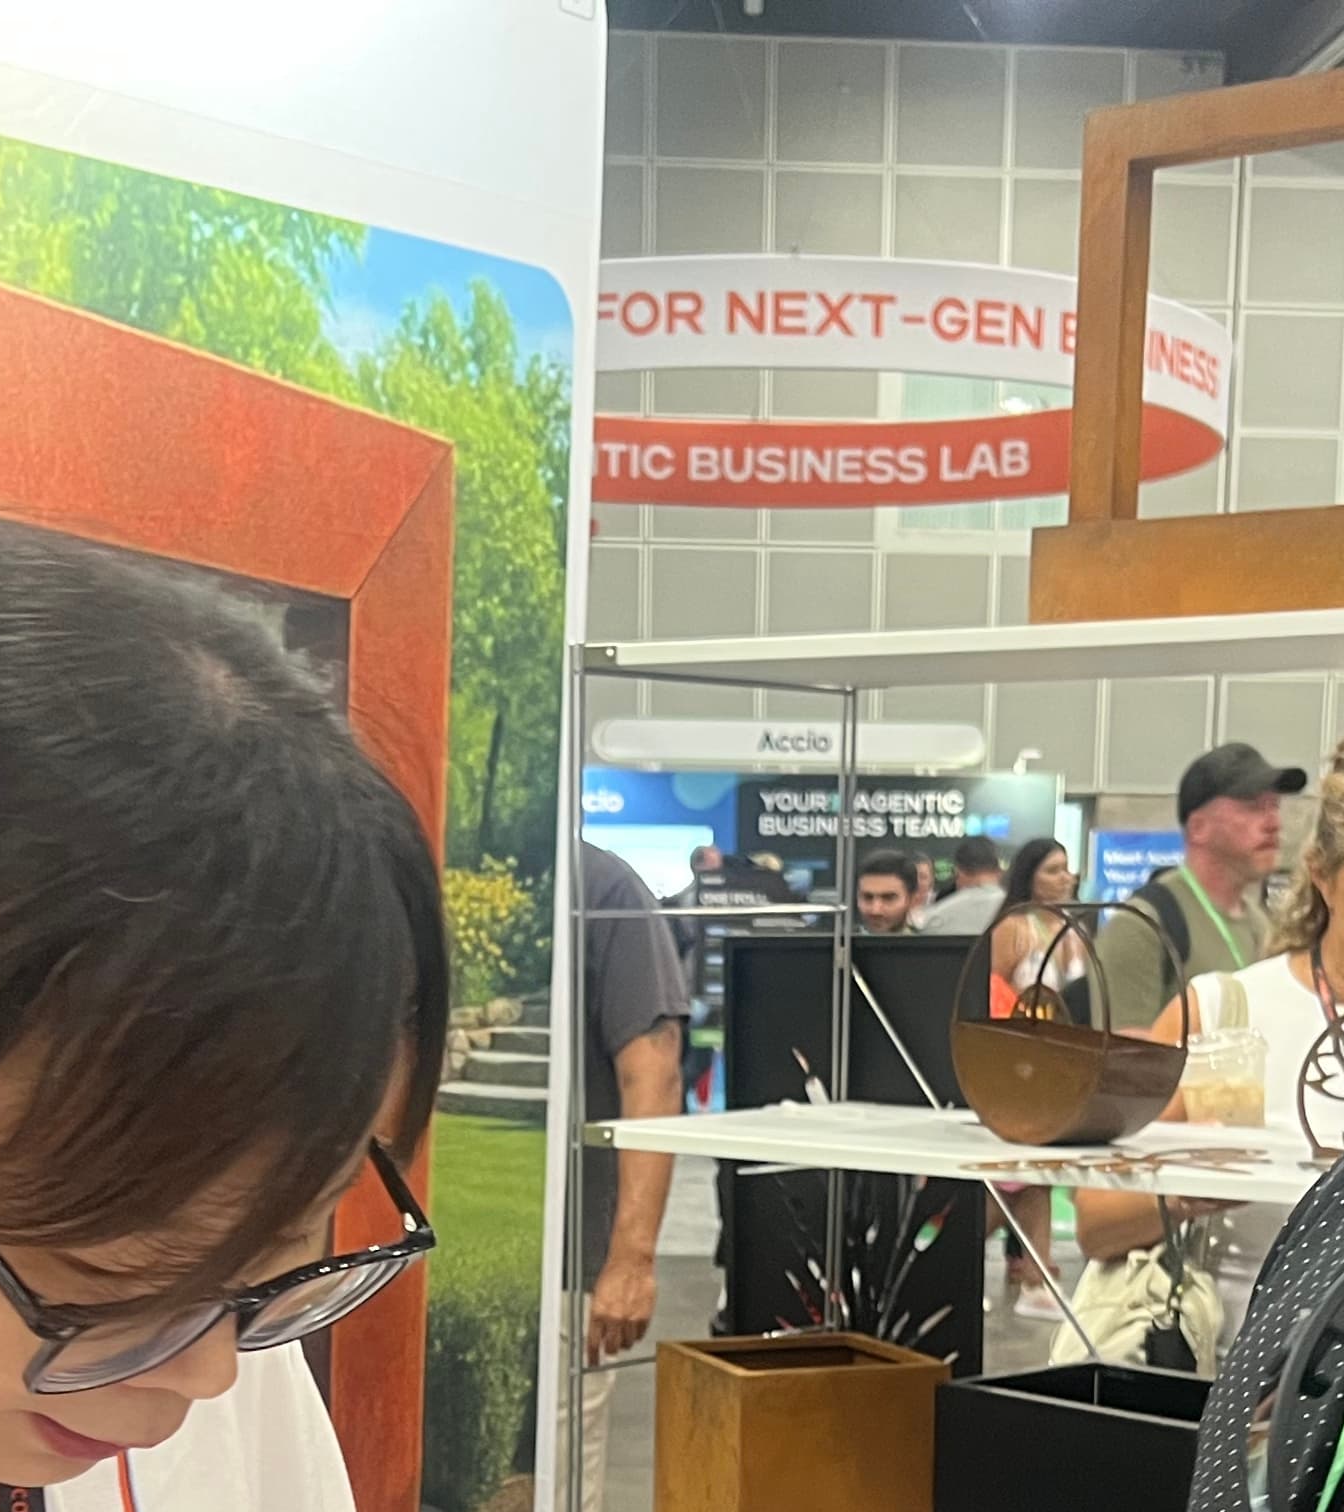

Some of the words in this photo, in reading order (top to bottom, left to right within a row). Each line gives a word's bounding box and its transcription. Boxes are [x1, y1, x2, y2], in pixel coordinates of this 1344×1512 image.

[726, 289, 1045, 351] NEXT-GEN
[1059, 310, 1221, 400] BINESS
[688, 444, 928, 485] BUSINESS
[939, 440, 1031, 480] LAB
[759, 729, 833, 753] Accio
[760, 791, 827, 814] YOUR
[853, 790, 965, 815] AGENTIC
